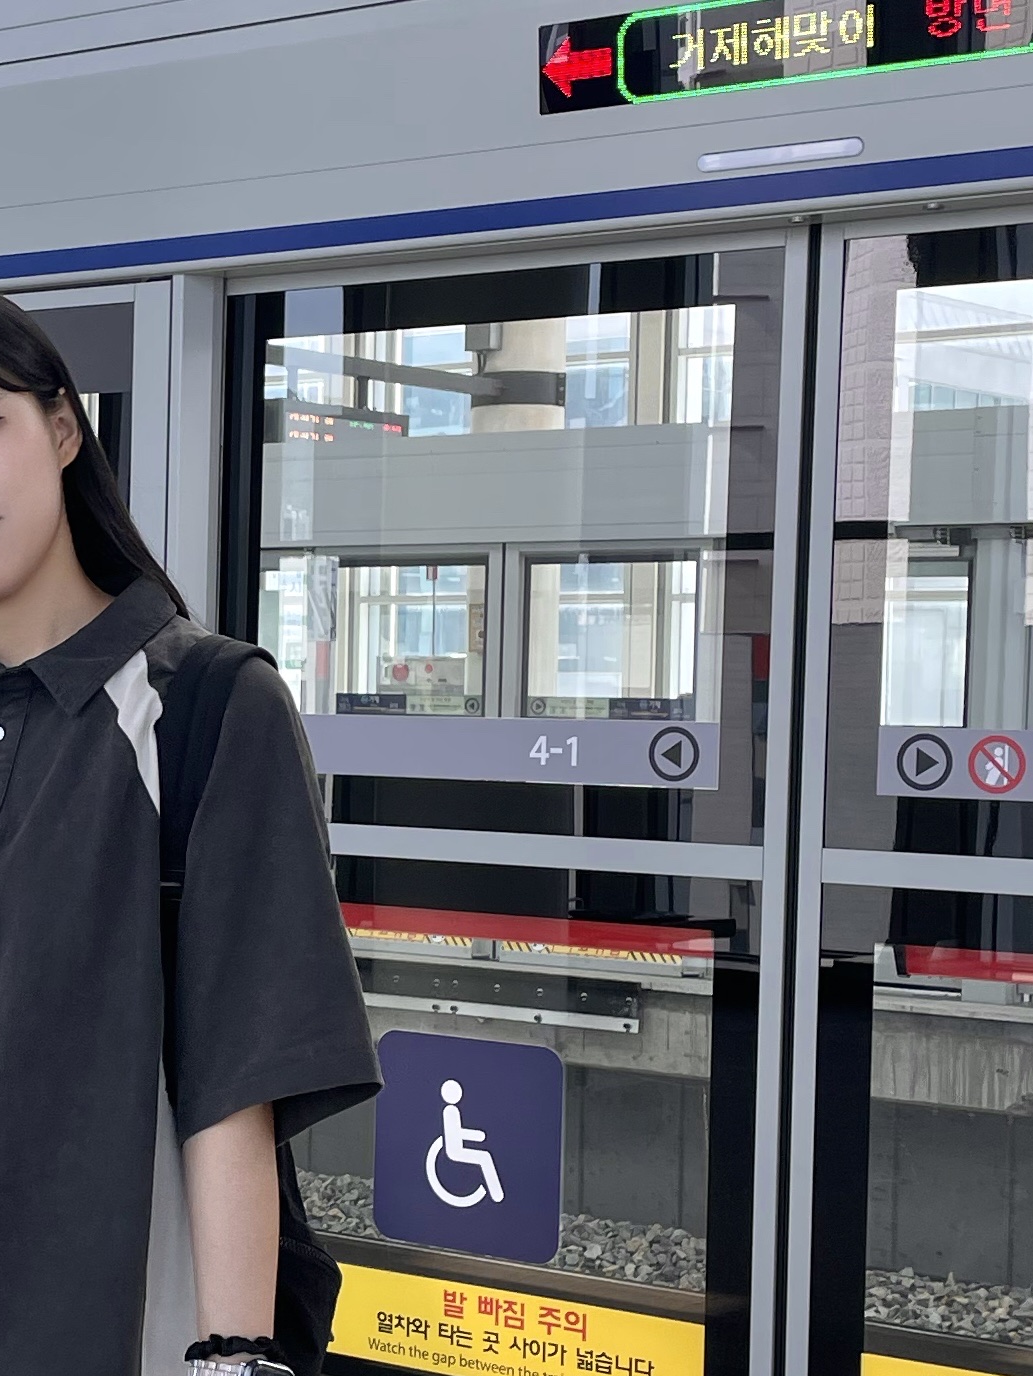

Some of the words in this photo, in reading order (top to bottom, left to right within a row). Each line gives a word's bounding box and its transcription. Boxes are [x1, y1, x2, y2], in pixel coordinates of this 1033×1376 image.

[669, 4, 874, 70] 거제해맞이
[529, 735, 578, 767] 4-1
[376, 1311, 431, 1341] 열차와
[438, 1322, 473, 1349] 타는
[482, 1330, 500, 1355] 곳
[509, 1336, 568, 1366] 사이가
[443, 1289, 467, 1319] 발
[477, 1295, 525, 1330] 빠짐
[537, 1305, 587, 1342] 주의
[368, 1336, 406, 1356] Watch
[408, 1345, 429, 1360] the
[432, 1351, 456, 1368] gap
[459, 1353, 515, 1376] between
